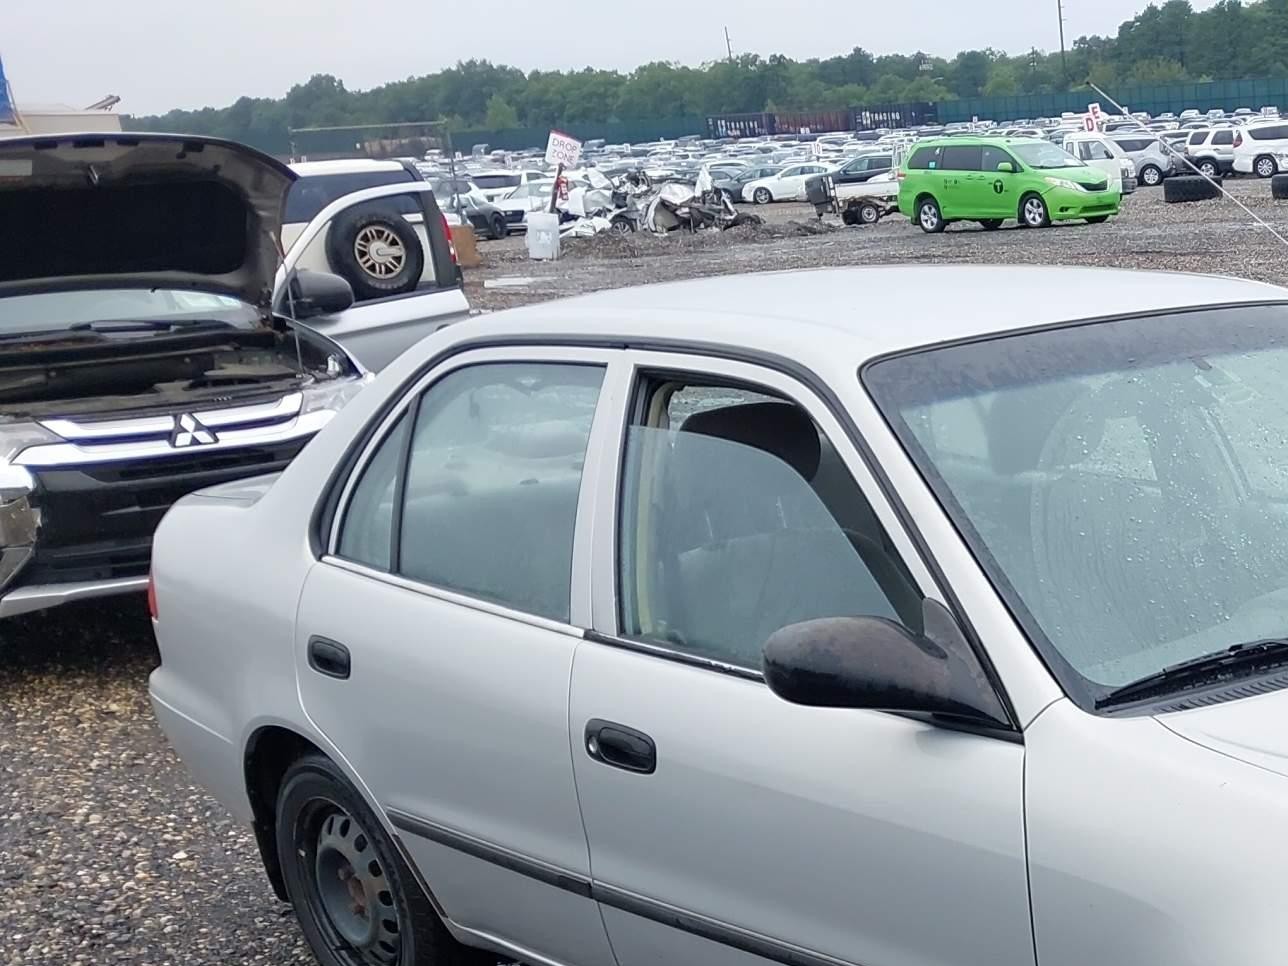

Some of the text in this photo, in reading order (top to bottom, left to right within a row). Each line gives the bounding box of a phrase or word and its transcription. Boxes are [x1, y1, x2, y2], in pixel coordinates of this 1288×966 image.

[1091, 106, 1100, 119] E
[1085, 117, 1094, 131] D
[552, 138, 577, 153] DROP
[551, 149, 576, 165] ZONE
